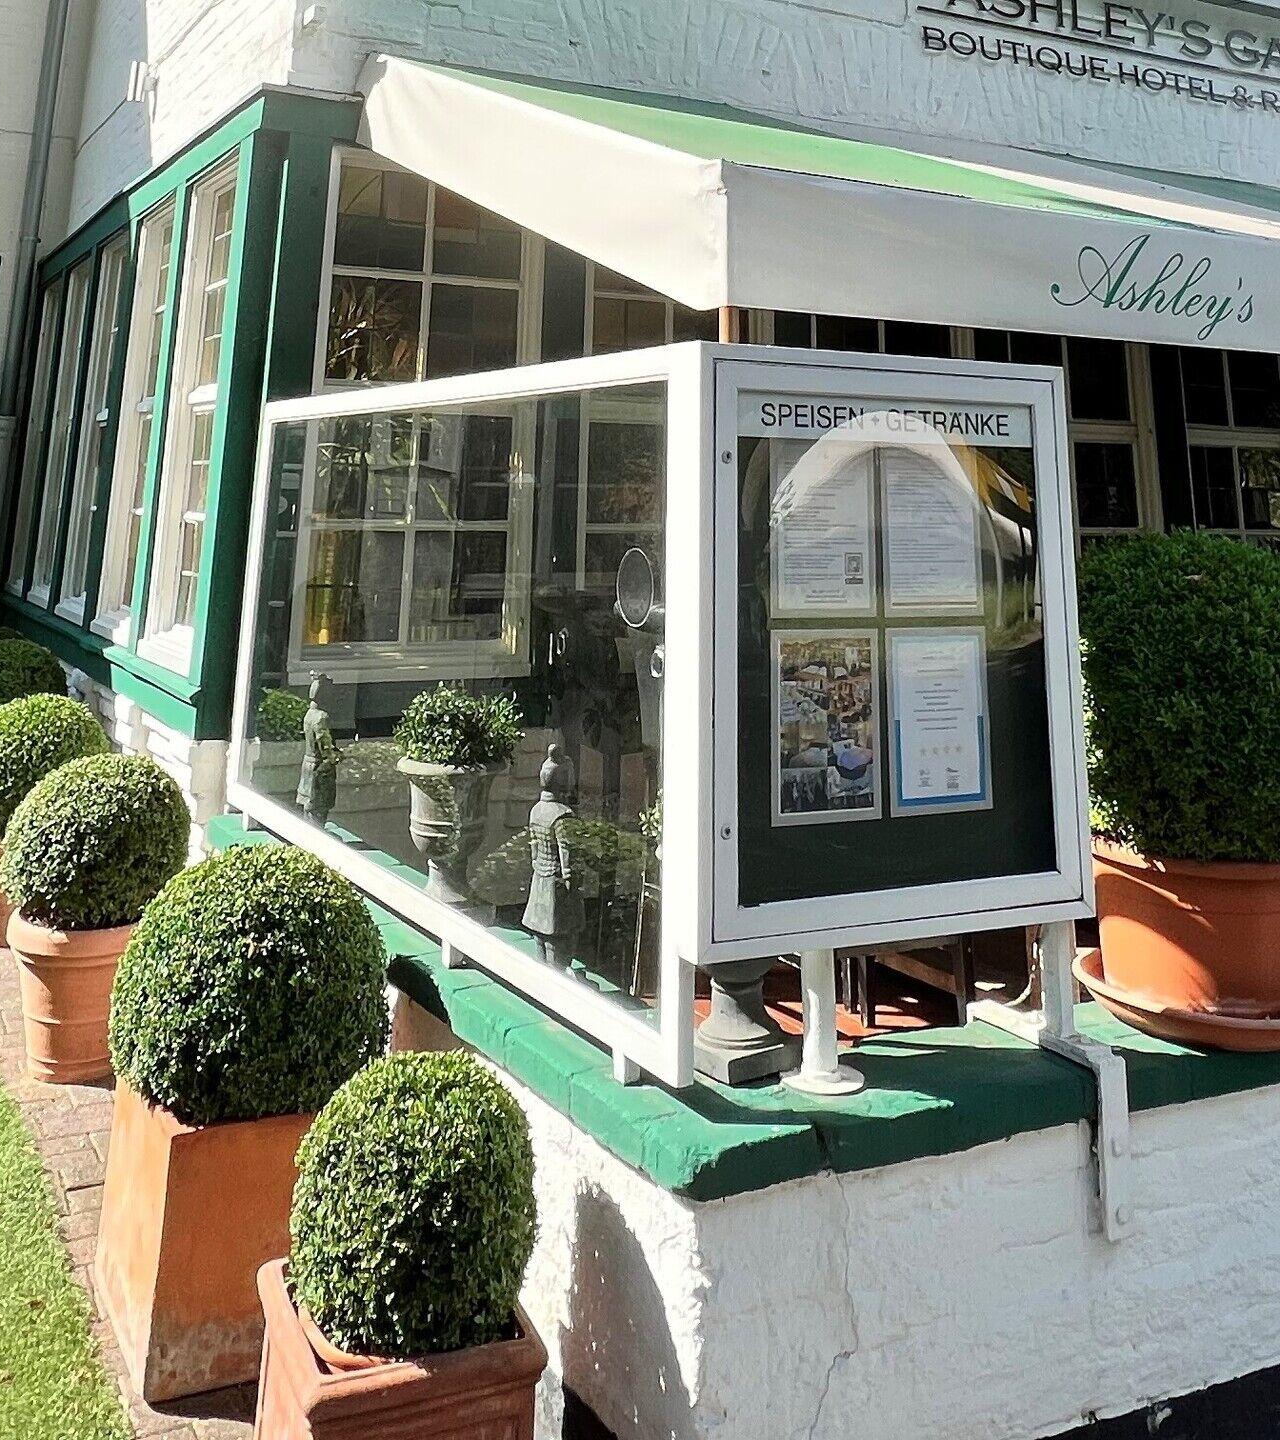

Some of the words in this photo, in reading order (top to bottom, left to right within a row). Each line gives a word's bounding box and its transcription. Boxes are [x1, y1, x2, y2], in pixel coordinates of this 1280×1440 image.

[921, 25, 1111, 83] BOUTIQUE
[1117, 61, 1228, 106] HOTEL
[1231, 84, 1254, 110] &
[1050, 233, 1254, 341] Ashley's
[760, 402, 865, 430] SPEISEN
[885, 408, 1010, 437] GETRÄNKE
